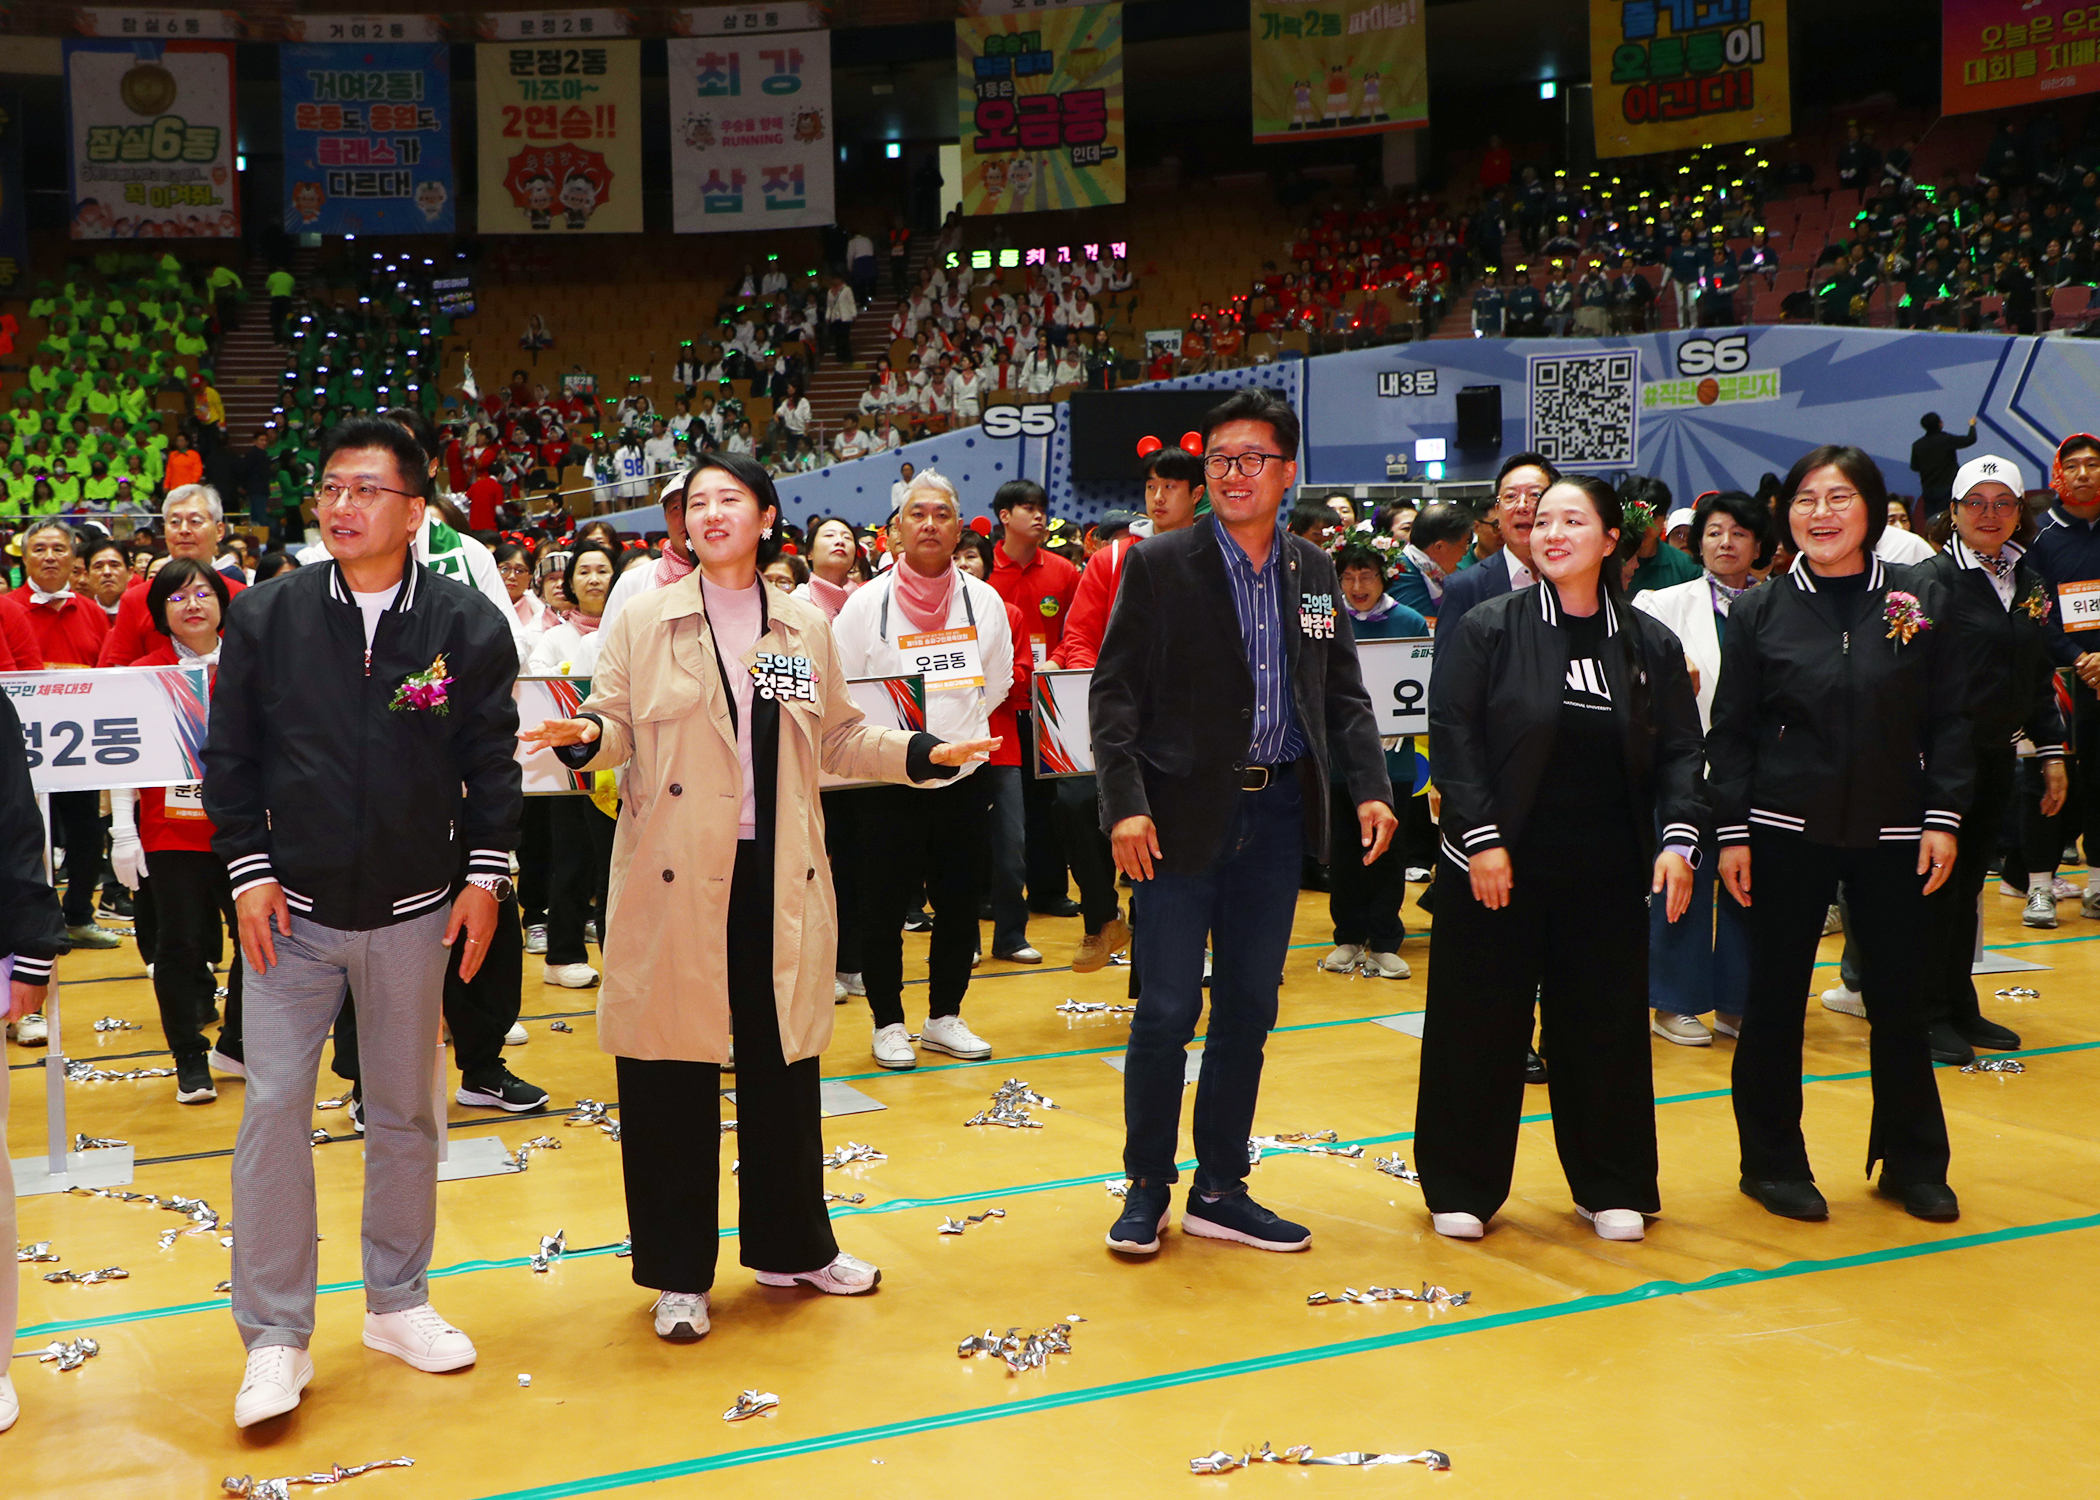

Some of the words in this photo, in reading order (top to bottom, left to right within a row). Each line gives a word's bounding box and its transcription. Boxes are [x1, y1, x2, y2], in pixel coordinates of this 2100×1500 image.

[122, 17, 199, 33] 잠실6동
[330, 24, 404, 38] 거여2동
[521, 18, 594, 35] 문정2동
[723, 12, 779, 30] 삼전동
[1259, 9, 1342, 40] 가락2동
[1981, 15, 2055, 53] 오늘은
[509, 49, 607, 76] 문정2동
[1964, 49, 2038, 85] 대회를
[2046, 36, 2100, 72] 지배
[307, 70, 425, 101] 거여2동!
[975, 80, 1014, 98] 1등은
[1623, 68, 1754, 124] 이긴다!
[502, 104, 616, 139] 2연승!!
[974, 88, 1107, 154] 오금동
[86, 115, 220, 162] 잠실6동
[317, 137, 422, 167] 클래스가
[721, 133, 784, 148] RUNNING
[124, 183, 146, 205] 꼭
[1677, 334, 1750, 376] S6
[1378, 370, 1438, 397] 내3문
[982, 404, 1058, 439] S5
[624, 459, 645, 476] 98
[1301, 593, 1333, 615] 구의원
[1300, 613, 1335, 640] 박종현
[756, 652, 811, 679] 구의원
[916, 652, 966, 672] 오금동
[3, 684, 36, 697] 구민
[37, 683, 93, 696] 체육대회
[753, 672, 816, 702] 정주리
[1563, 700, 1585, 708] NATIONAL
